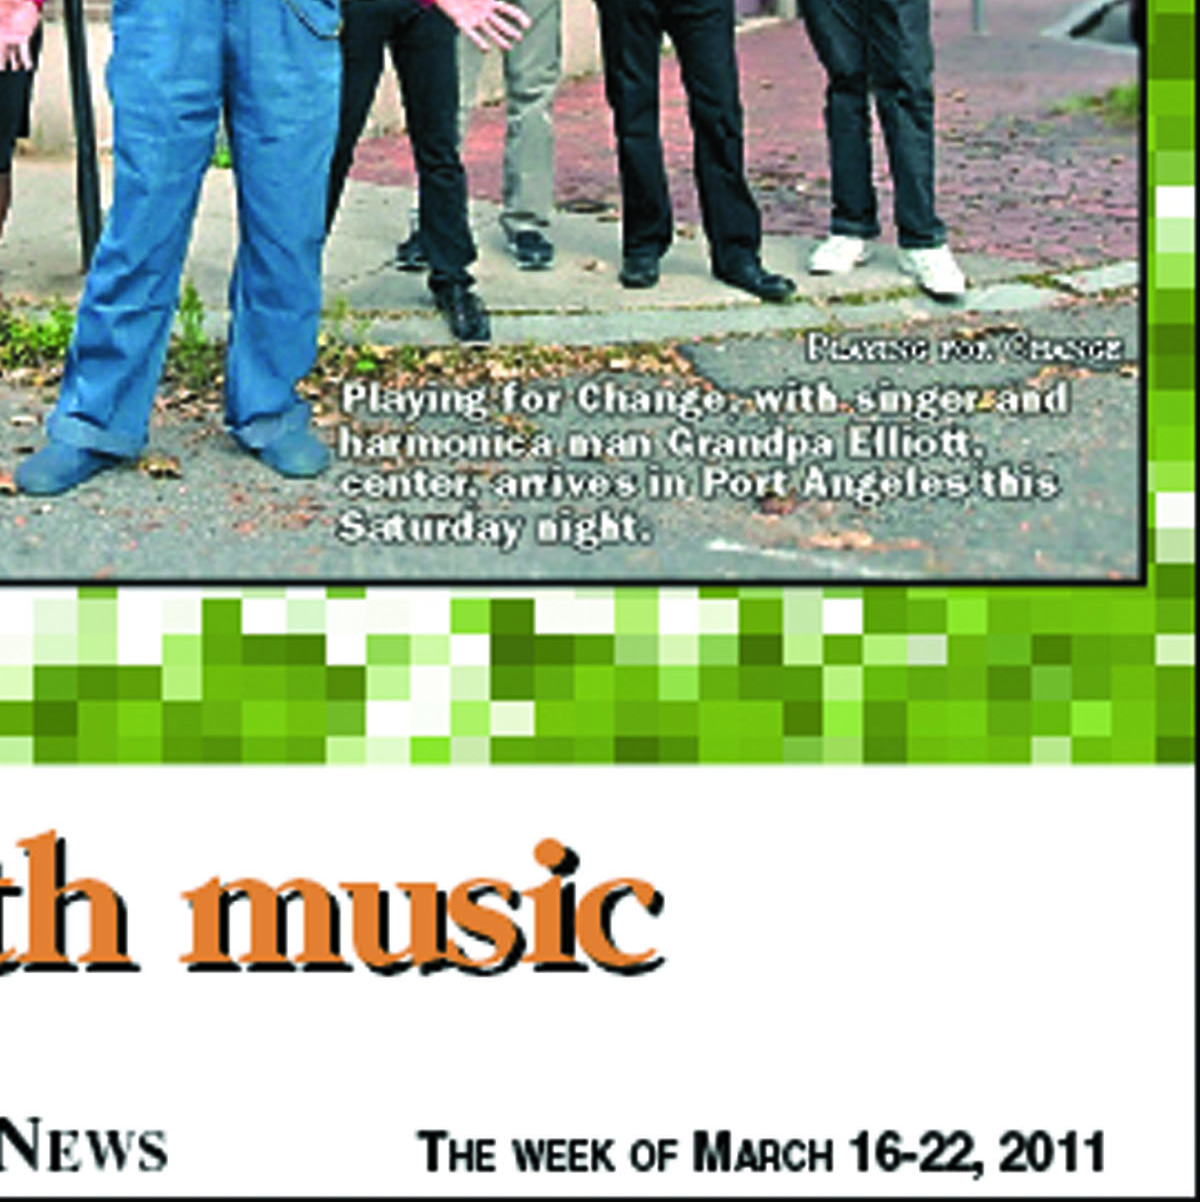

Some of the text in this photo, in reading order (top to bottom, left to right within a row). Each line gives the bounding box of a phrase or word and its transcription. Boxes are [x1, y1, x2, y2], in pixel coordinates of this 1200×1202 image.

[179, 837, 667, 978] music
[417, 1129, 496, 1173] THE
[693, 1129, 834, 1173] MARCH
[849, 1129, 984, 1181] 16-22,
[999, 1129, 1104, 1173] 2011
